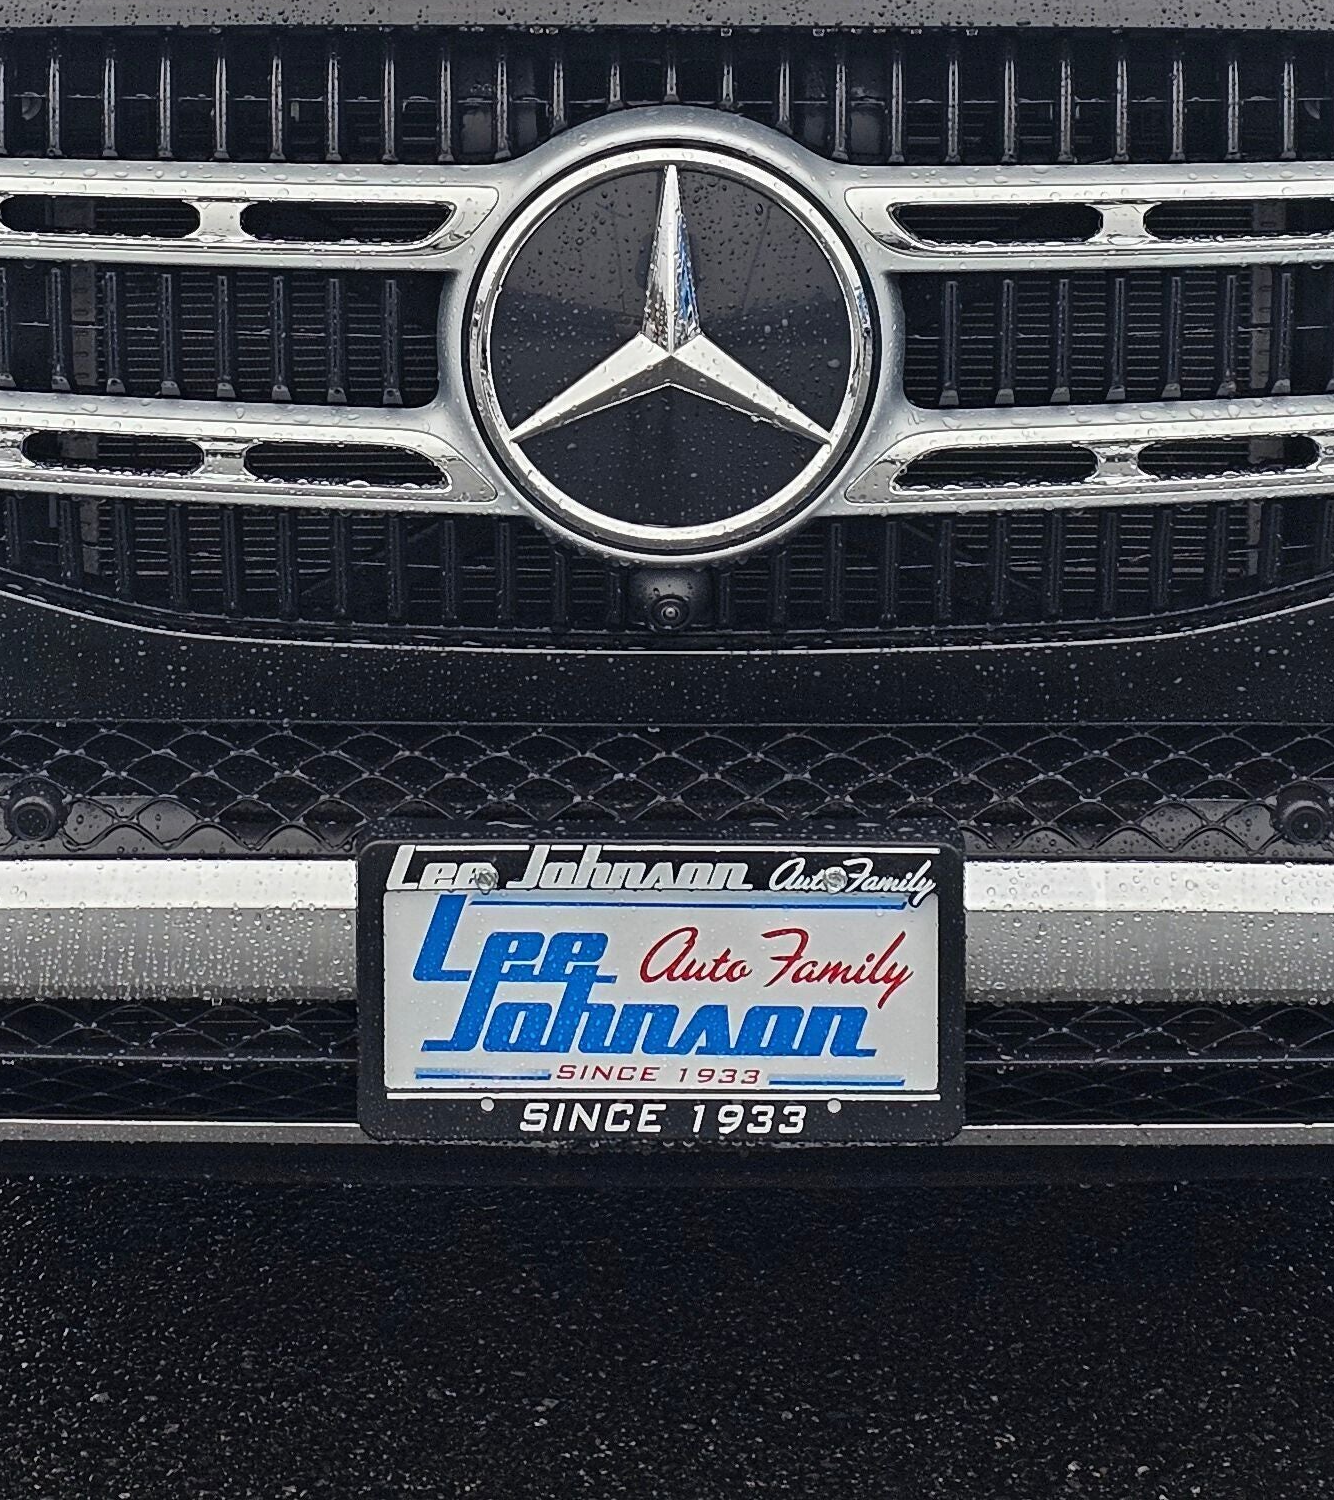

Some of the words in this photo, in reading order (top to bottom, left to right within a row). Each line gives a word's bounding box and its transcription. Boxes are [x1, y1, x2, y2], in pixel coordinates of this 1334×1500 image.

[505, 844, 753, 890] Johnson
[768, 857, 848, 893] Aut
[842, 857, 937, 906] Family
[413, 894, 618, 982] Lee
[639, 926, 753, 983] Auto
[761, 927, 915, 1010] Family
[420, 980, 877, 1058] Johnson
[556, 1064, 661, 1083] SINCE
[678, 1067, 762, 1085] 1933
[519, 1102, 668, 1134] SINCE
[691, 1104, 808, 1136] 1933
